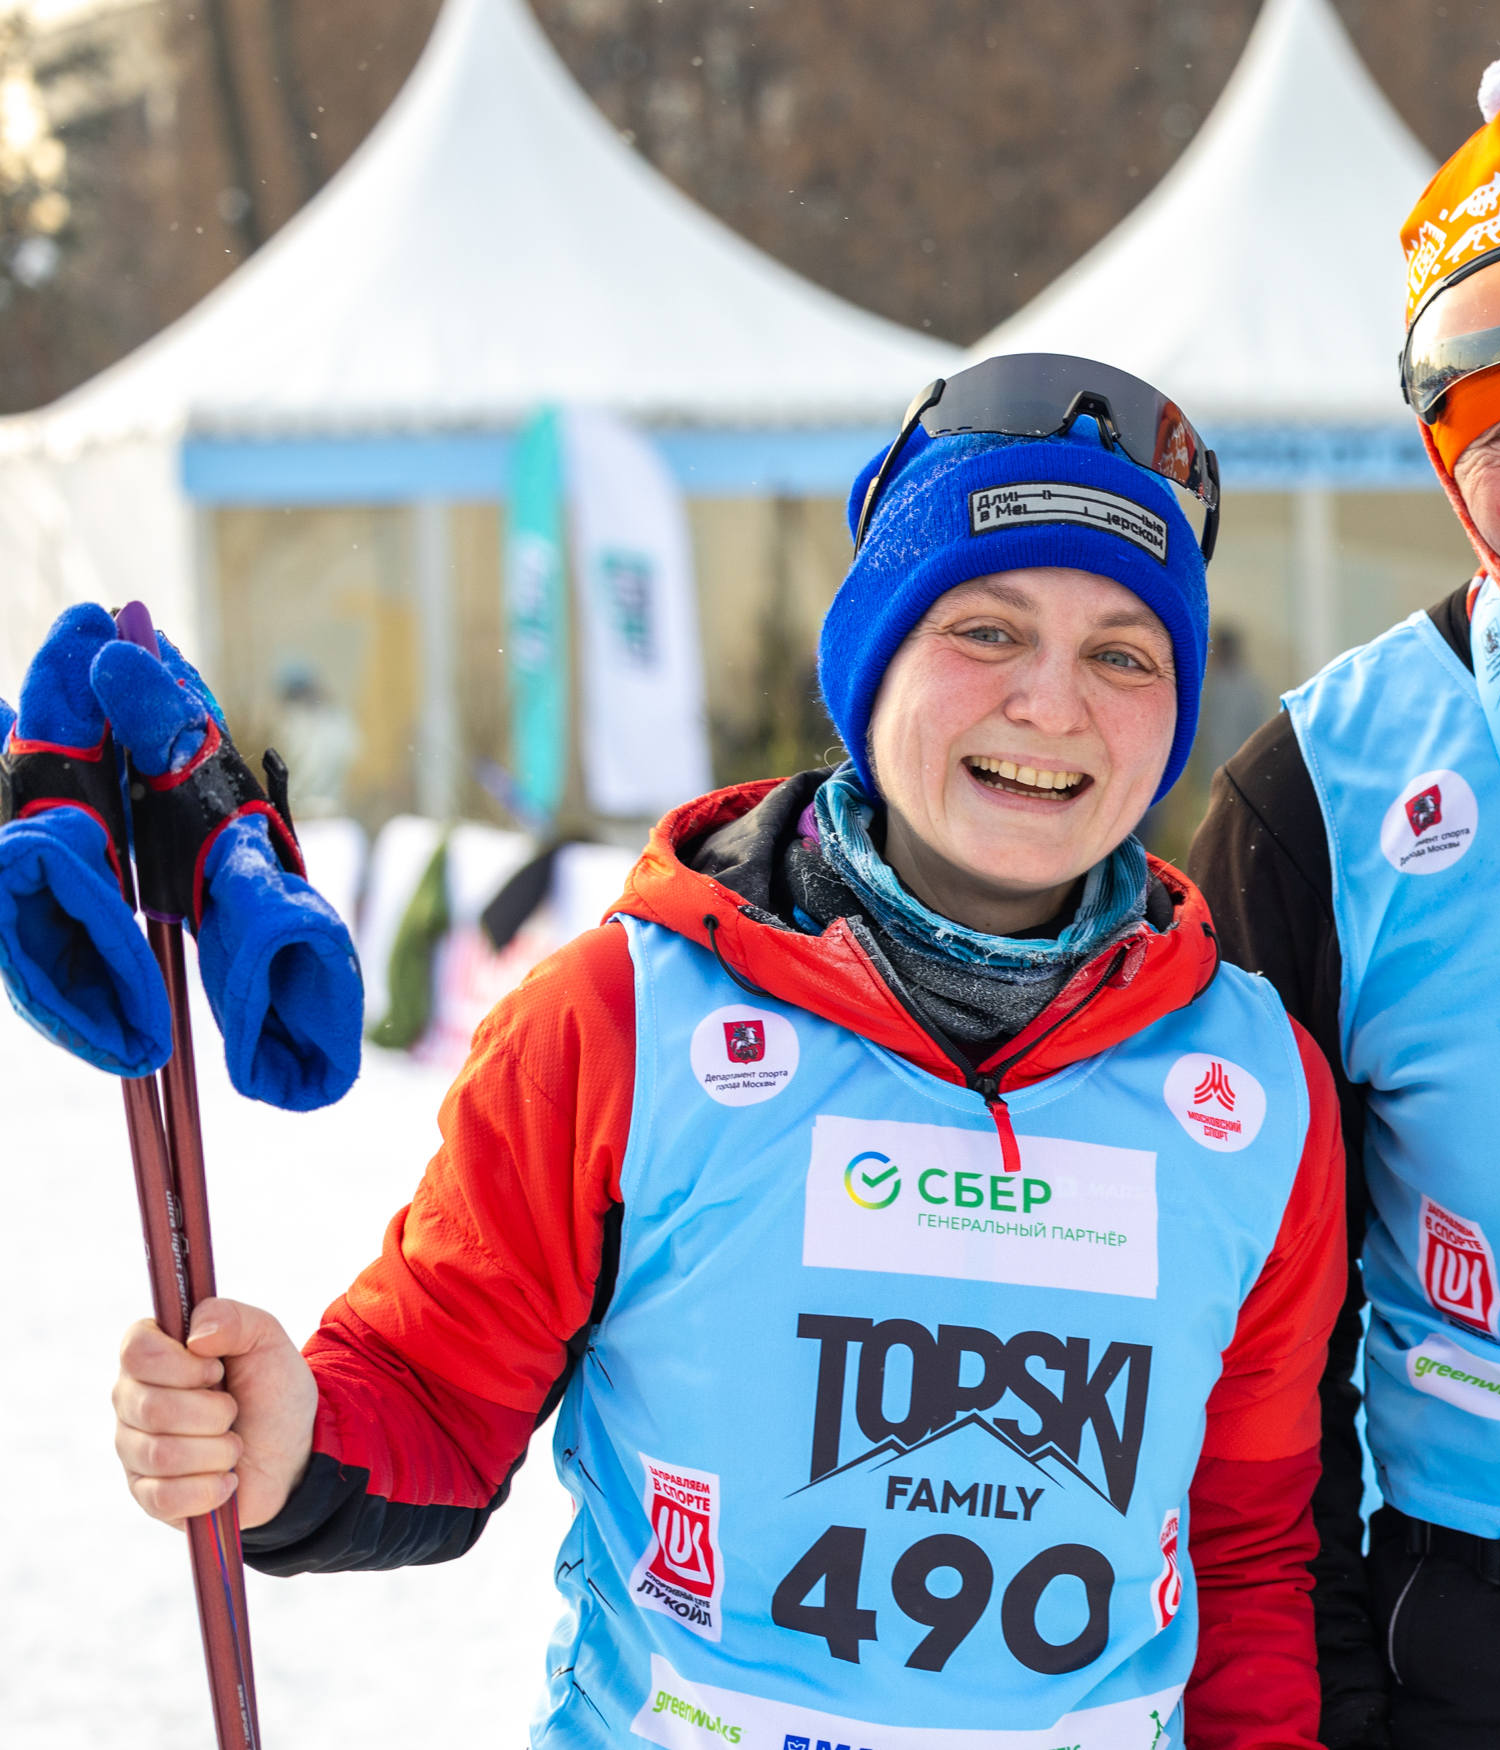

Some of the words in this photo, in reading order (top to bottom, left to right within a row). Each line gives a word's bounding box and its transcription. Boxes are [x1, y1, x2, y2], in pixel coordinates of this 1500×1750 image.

[705, 1071, 756, 1083] Департамент
[758, 1070, 788, 1079] спорта
[742, 1080, 776, 1088] Москвы
[1187, 1110, 1242, 1134] МОСКОВСКИЙ
[1203, 1125, 1228, 1142] СПОРТ
[918, 1168, 1052, 1213] СБЕР
[918, 1213, 1047, 1239] ГЕНЕРАЛЬНЫЙ
[1052, 1226, 1127, 1247] ПАРТНЁР
[1425, 1216, 1433, 1231] В
[1434, 1221, 1483, 1251] СПОРТЕ
[796, 1312, 1154, 1518] TOPSKI
[648, 1465, 711, 1494] ЗАПРАВЛЯЕМ
[653, 1477, 662, 1491] В
[663, 1482, 711, 1512] СПОРТЕ
[885, 1475, 1046, 1522] FAMILY
[636, 1579, 713, 1628] ЛУКОЙЛ
[770, 1524, 1116, 1676] 490
